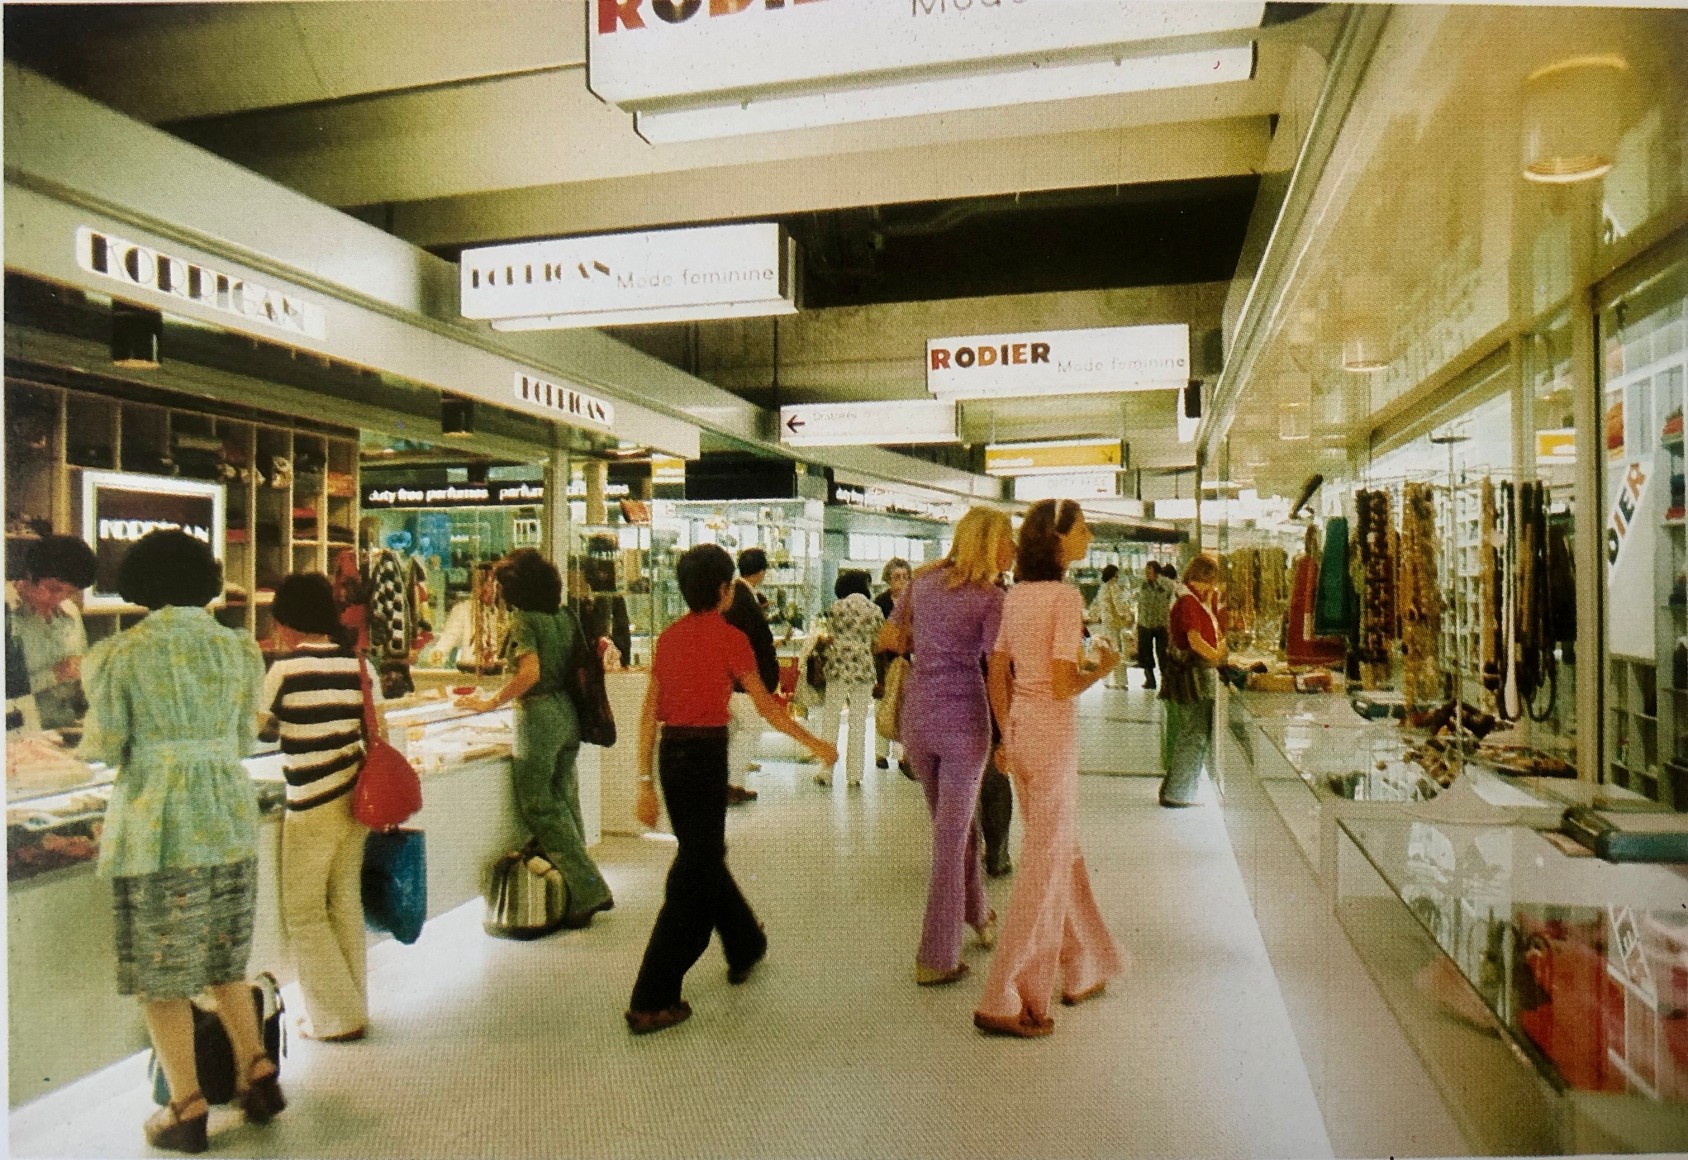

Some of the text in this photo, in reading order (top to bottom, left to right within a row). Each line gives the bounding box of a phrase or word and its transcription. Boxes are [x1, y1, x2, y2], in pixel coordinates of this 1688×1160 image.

[90, 232, 305, 332] KORRIGAN
[617, 272, 674, 289] Mode
[931, 342, 1051, 371] RODIER
[1057, 359, 1104, 373] Mode
[369, 490, 396, 504] duty
[1608, 462, 1646, 566] DIER
